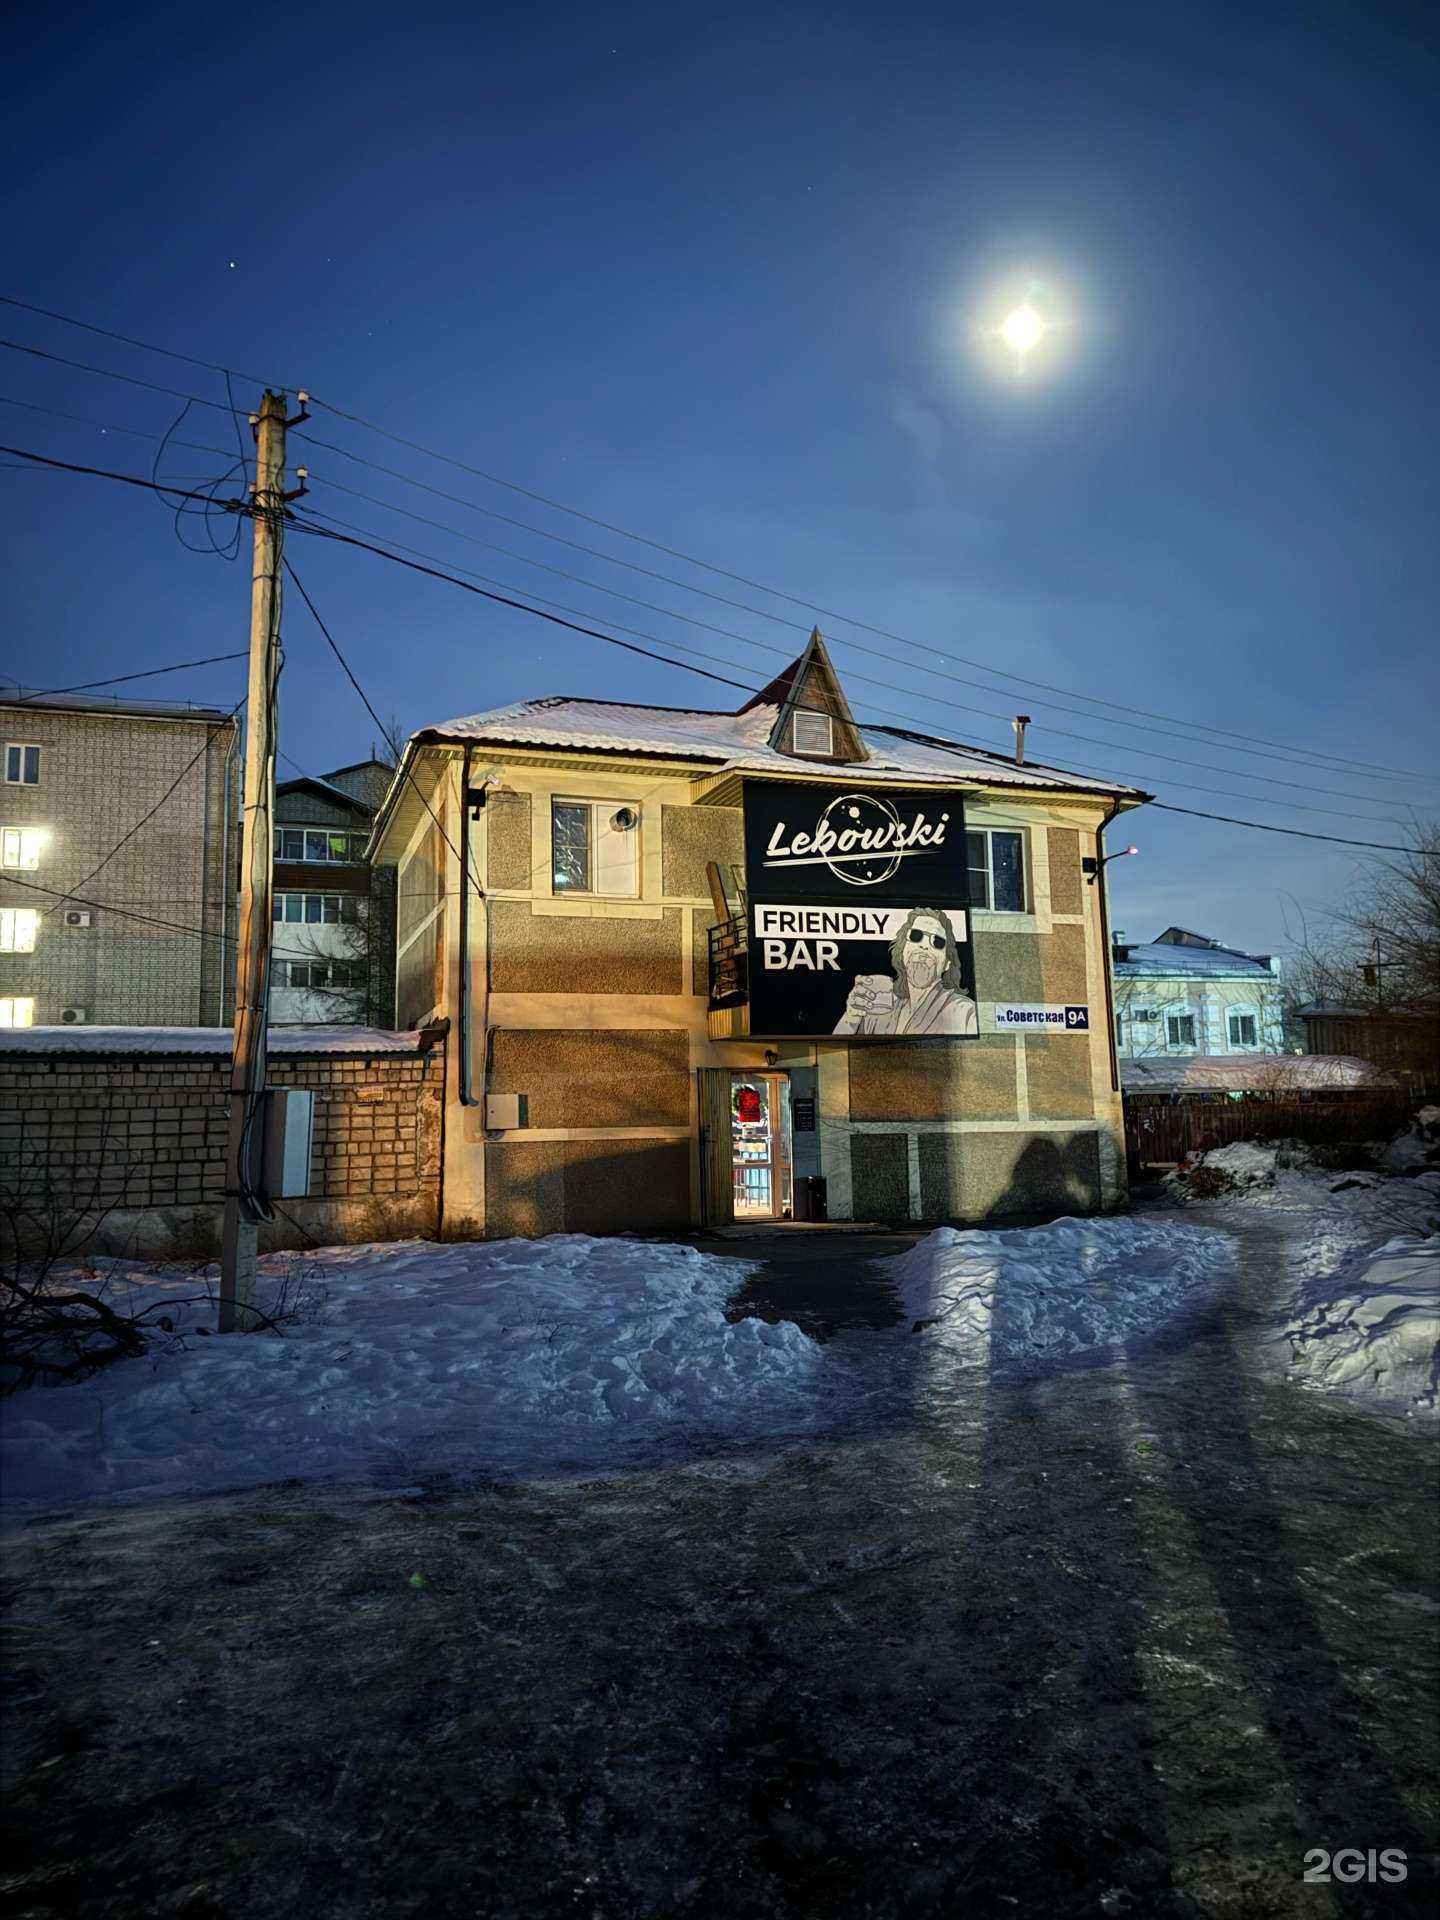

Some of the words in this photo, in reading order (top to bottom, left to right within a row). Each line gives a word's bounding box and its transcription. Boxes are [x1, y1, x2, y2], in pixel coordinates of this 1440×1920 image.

[766, 813, 950, 857] Lebowski
[763, 910, 889, 934] FRIENDLY
[763, 939, 841, 971] BAR
[1006, 1009, 1064, 1023] Советская
